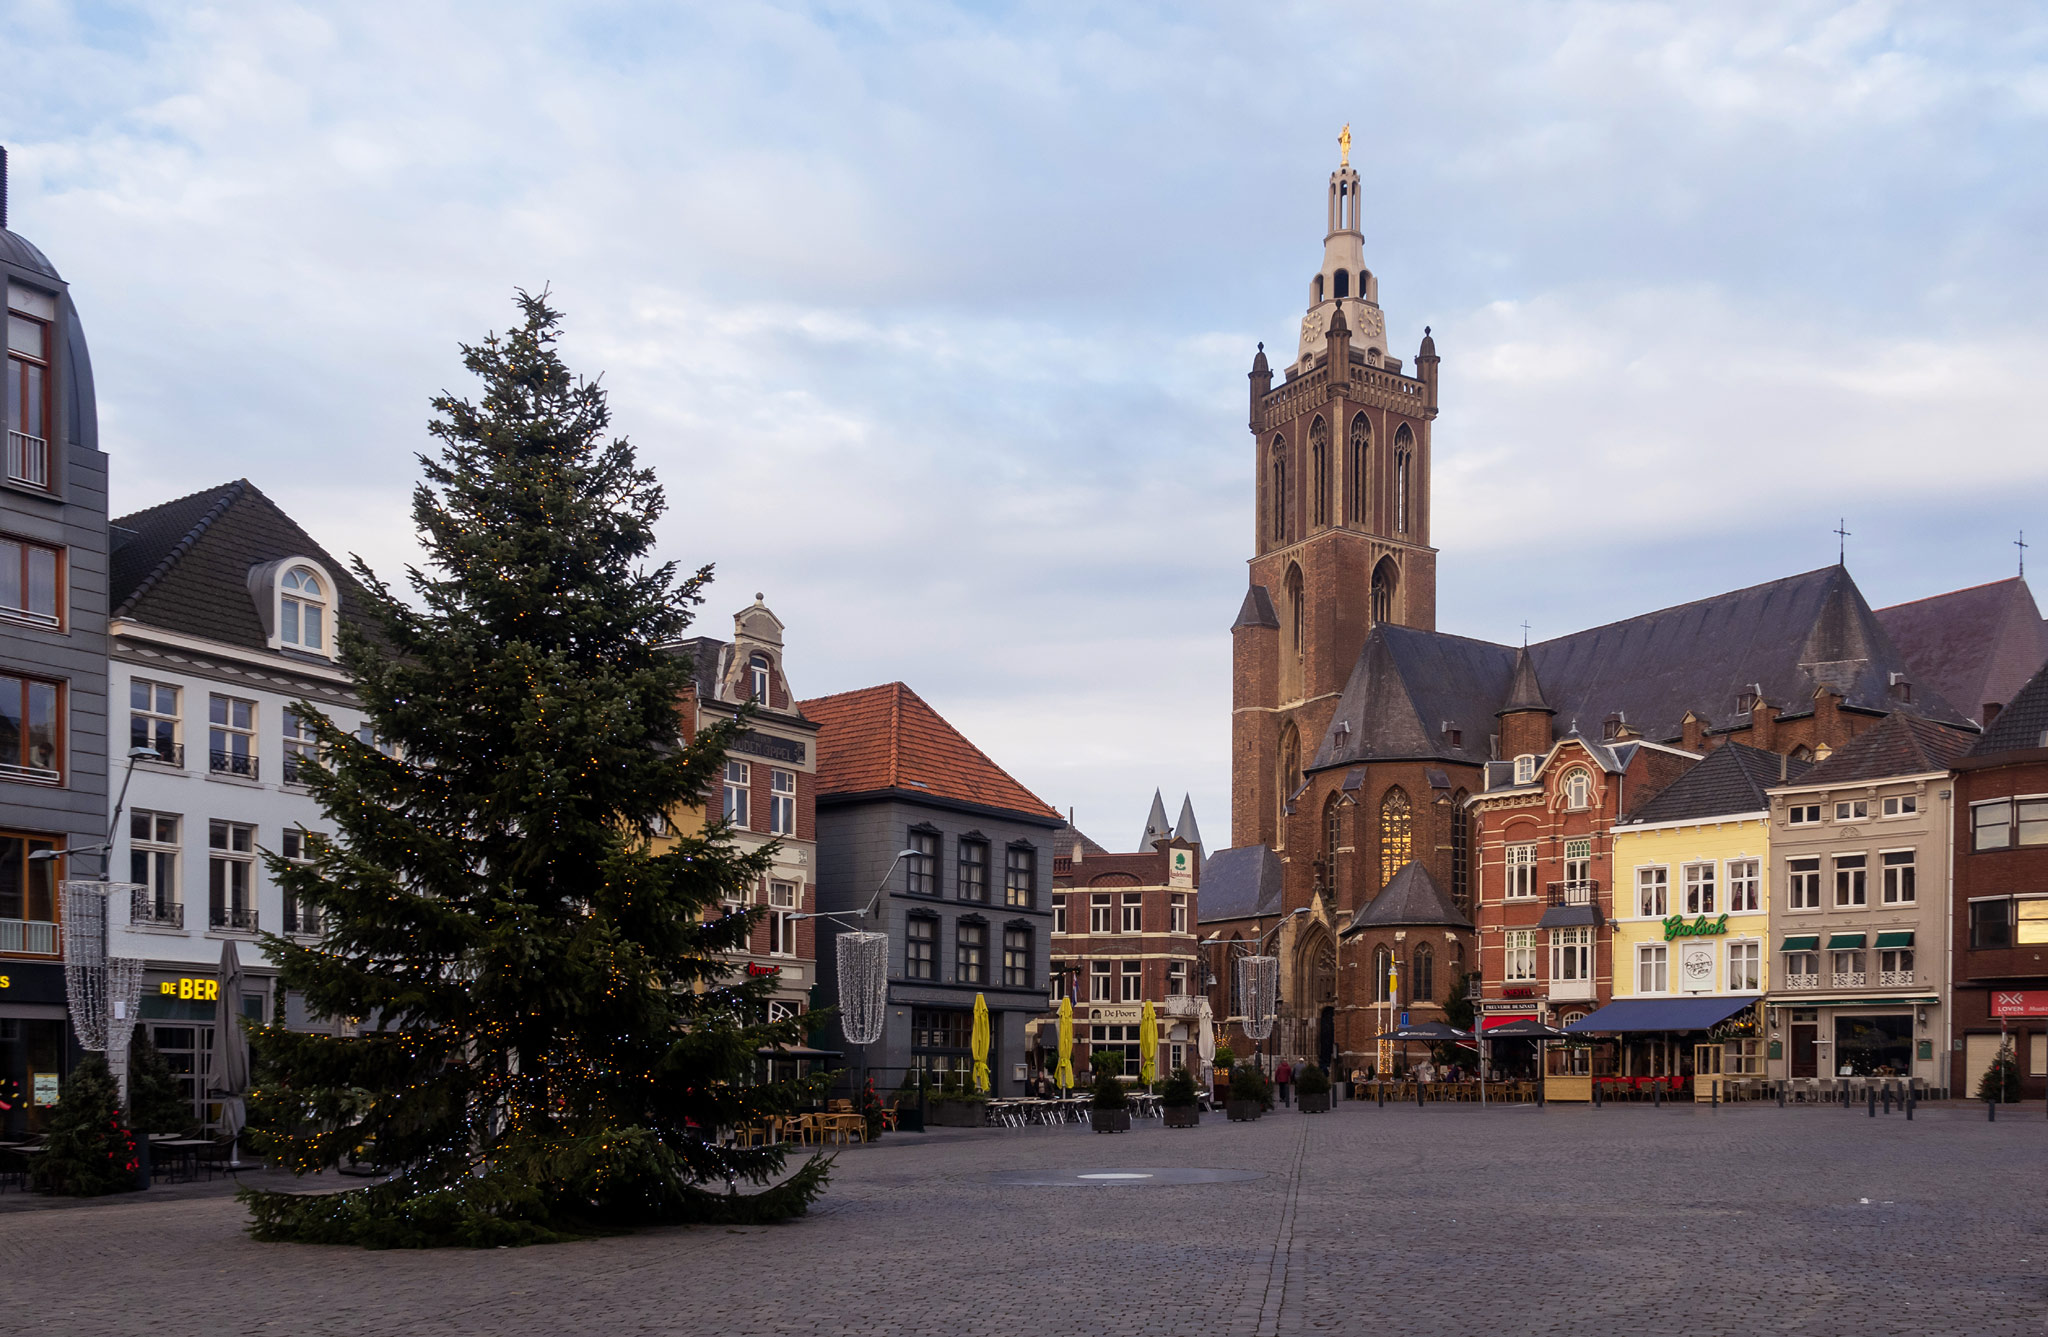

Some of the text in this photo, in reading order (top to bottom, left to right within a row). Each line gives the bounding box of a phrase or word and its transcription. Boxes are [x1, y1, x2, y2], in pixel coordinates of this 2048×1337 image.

[1662, 913, 1728, 941] Grolsch
[161, 978, 219, 1001] DE BER
[1104, 1010, 1136, 1018] De Poort
